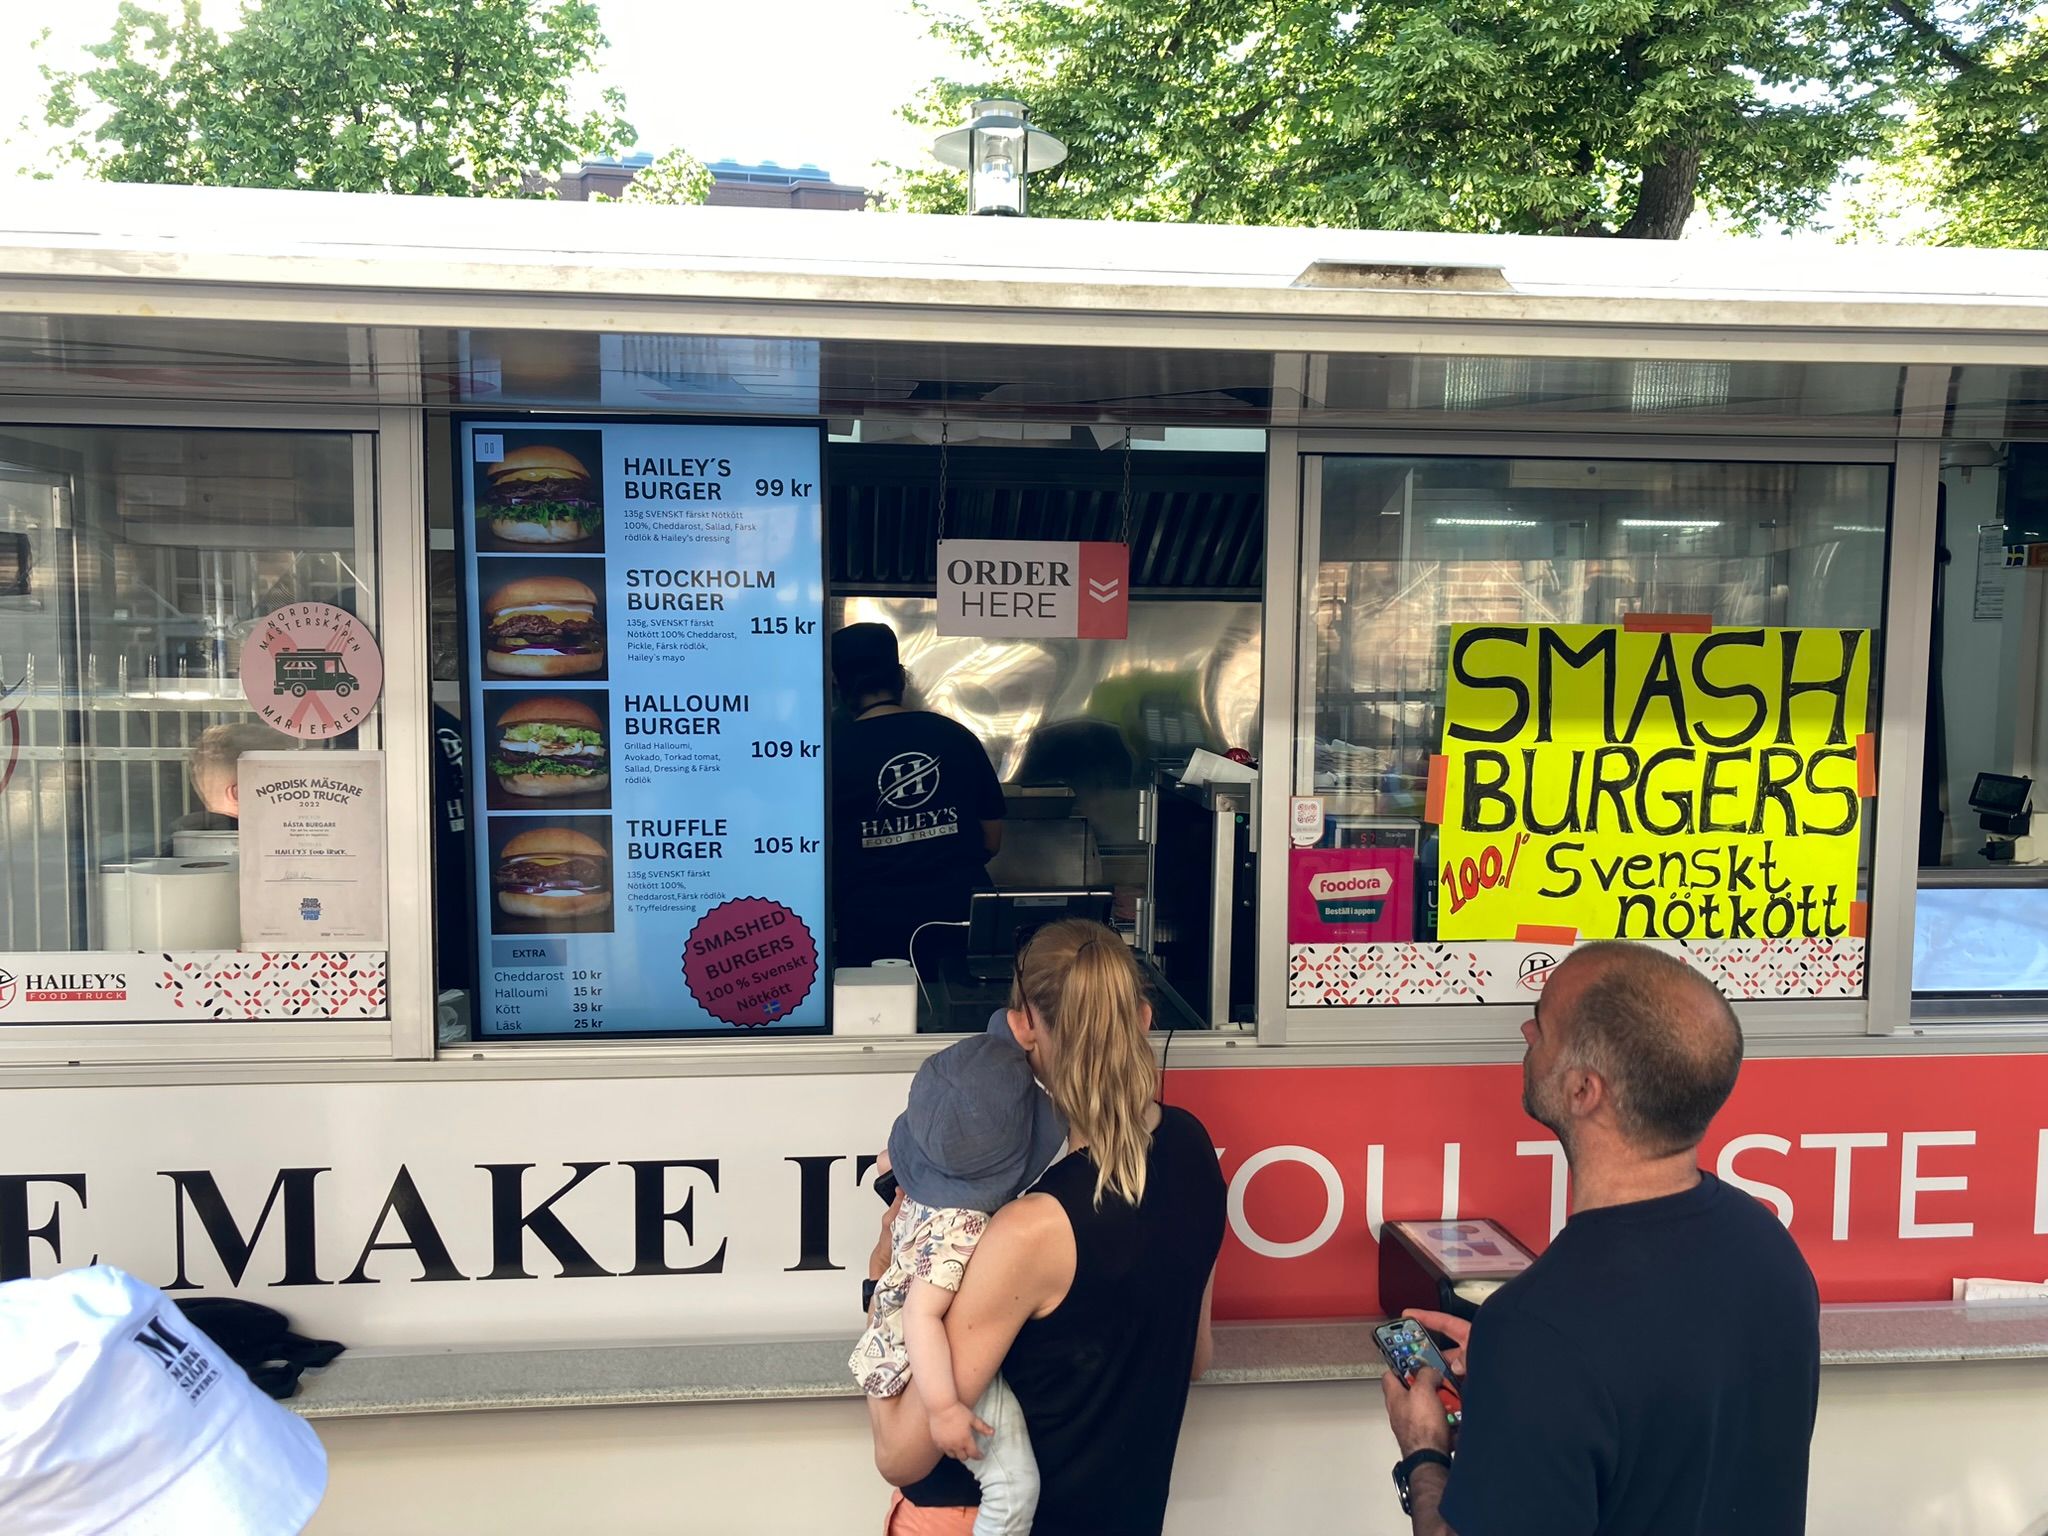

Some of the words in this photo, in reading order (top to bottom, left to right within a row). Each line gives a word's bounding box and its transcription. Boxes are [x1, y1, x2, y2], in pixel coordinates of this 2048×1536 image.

[625, 482, 722, 500] BURGER
[755, 479, 784, 497] 99
[791, 479, 813, 497] kr
[624, 510, 643, 520] 135g
[646, 510, 684, 518] SVENSKT
[624, 522, 651, 531] 100%,
[652, 522, 704, 531] Cheddarost,
[705, 523, 733, 532] Sallad,
[653, 534, 659, 542] &
[695, 535, 730, 544] dressing
[626, 569, 776, 589] STOCKHOLM
[947, 559, 1071, 586] ORDER
[627, 592, 724, 611] BURGER
[962, 591, 1056, 618] HERE
[268, 606, 351, 629] NORDISKA
[650, 619, 688, 627] SVENSKT
[750, 617, 788, 635] 115
[795, 617, 816, 635] kr
[661, 631, 685, 639] 100%
[687, 631, 737, 640] Cheddarost,
[628, 642, 654, 651] Pickle,
[662, 655, 685, 663] mayo
[1447, 626, 1866, 748] SMASH
[624, 695, 749, 712] HALLOUMI
[262, 705, 360, 735] MARIEFRED
[625, 717, 721, 735] BURGER
[624, 742, 651, 750] Grillad
[653, 742, 692, 751] Halloumi,
[751, 741, 793, 758] 109
[800, 740, 821, 758] kr
[624, 753, 662, 762] Avokado,
[665, 753, 692, 761] Torkad
[694, 754, 721, 762] tomat,
[625, 765, 653, 773] Sallad,
[654, 765, 690, 774] Dressing
[691, 765, 698, 773] &
[256, 779, 308, 797] NORDISK
[311, 777, 363, 797] MÄSTARE
[1461, 745, 1859, 837] BURGERS
[271, 796, 276, 804] I
[277, 790, 310, 803] FOOD
[313, 790, 350, 805] TRUCK
[626, 819, 728, 837] TRUFFLE
[866, 836, 902, 846] FOOD
[910, 825, 955, 840] TRUCK
[628, 842, 723, 860] BURGER
[754, 837, 793, 854] 105
[800, 836, 820, 853] kr
[627, 871, 646, 879] 135g
[648, 870, 685, 878] SVENSKT
[1538, 840, 1791, 898] Svenskt
[661, 882, 686, 890] 100%,
[1321, 877, 1380, 893] foodora
[635, 904, 696, 914] Tryffeldressing
[1325, 907, 1350, 915] Beställ
[1354, 908, 1376, 916] appen
[1614, 884, 1847, 939] nötkött
[693, 910, 786, 956] SMASHED
[513, 949, 546, 959] EXTRA
[705, 935, 794, 980] BURGERS
[26, 974, 127, 990] HAILEY'S
[494, 971, 564, 982] Cheddarost
[572, 971, 587, 980] 10
[590, 970, 602, 980] kr
[705, 983, 734, 1002] 100
[736, 977, 750, 990] %
[751, 955, 808, 984] Svenskt
[77, 992, 123, 1000] TRUCK
[495, 987, 548, 998] Halloumi
[574, 987, 587, 996] 15
[591, 986, 602, 996] kr
[736, 983, 793, 1012] Nötkött
[495, 1005, 520, 1014] Kött
[572, 1003, 588, 1013] 39
[591, 1003, 603, 1012] kr
[496, 1021, 522, 1031] Läsk
[574, 1019, 588, 1029] 25
[591, 1019, 603, 1028] kr
[1215, 1143, 1461, 1258] OU
[1516, 1130, 1977, 1242] TSTE
[157, 1158, 728, 1289] MAKE
[783, 1155, 878, 1271] I
[134, 1315, 189, 1370] M
